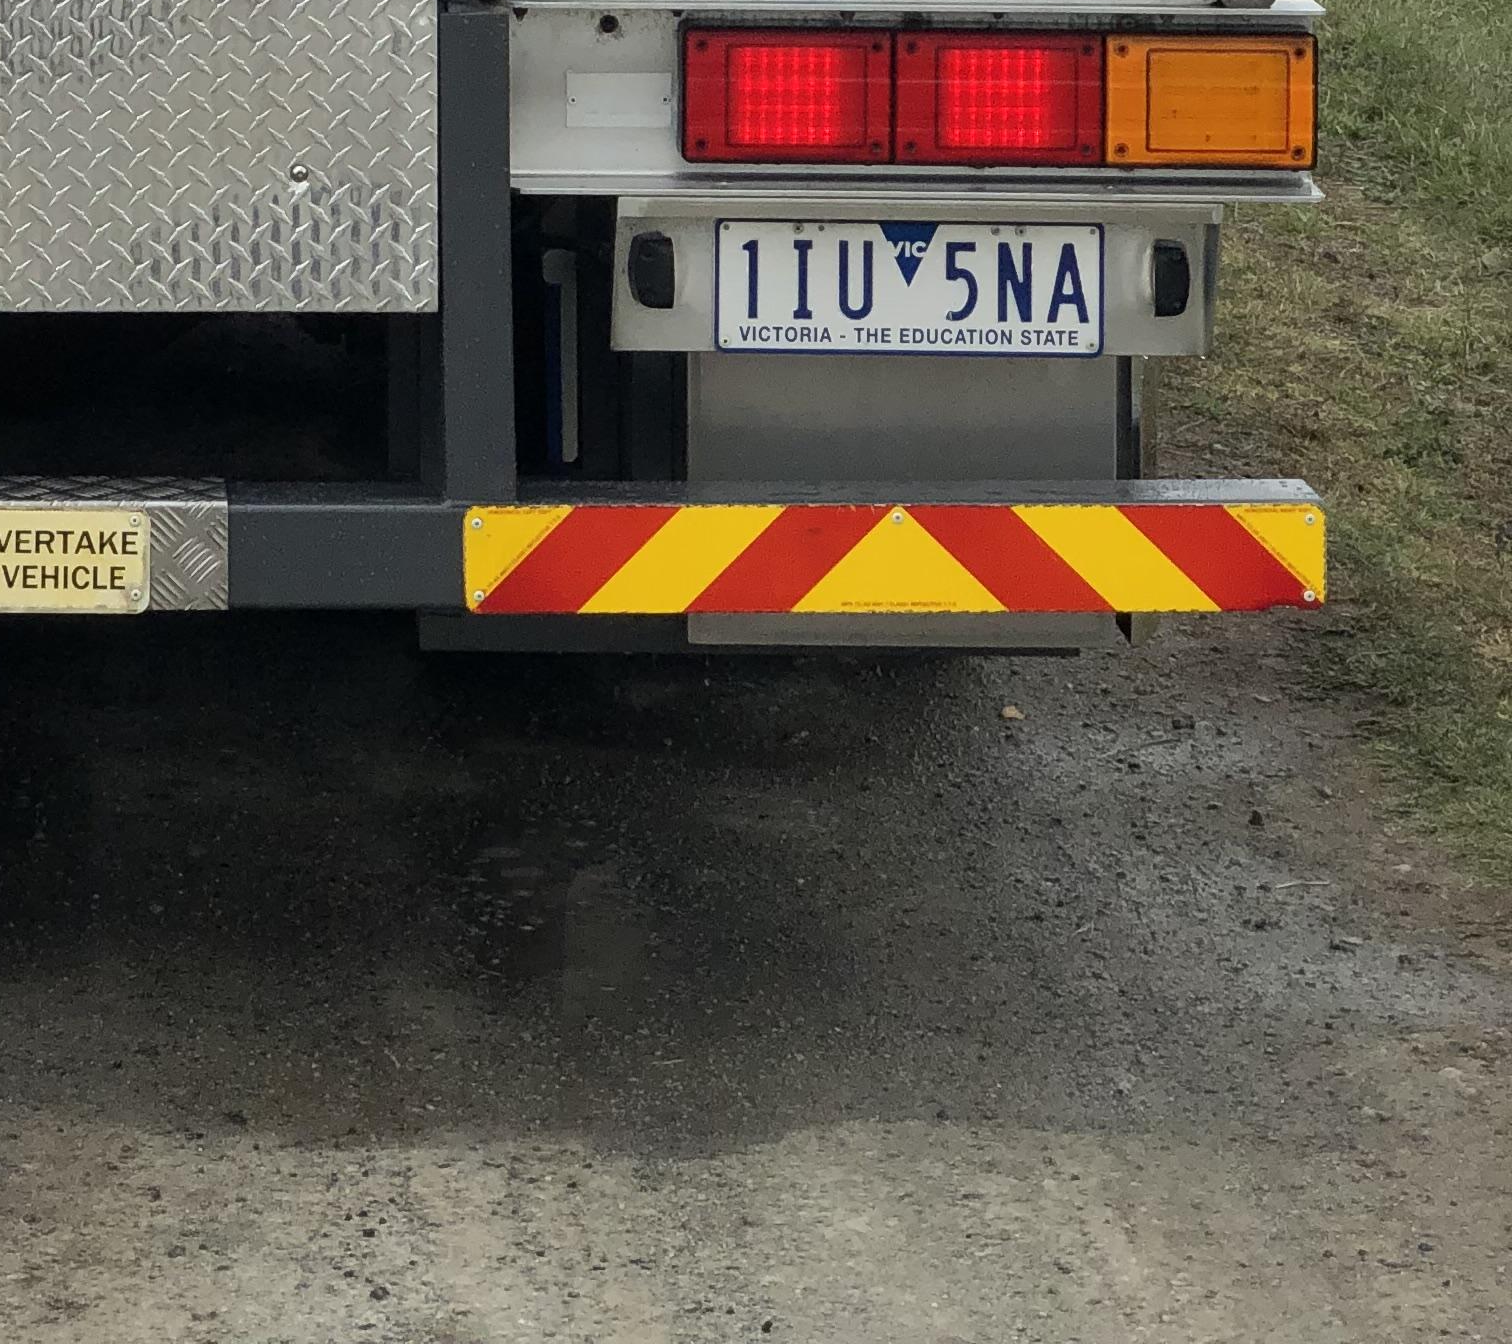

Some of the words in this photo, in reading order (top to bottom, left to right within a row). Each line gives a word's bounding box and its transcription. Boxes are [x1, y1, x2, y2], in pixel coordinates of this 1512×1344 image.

[888, 240, 927, 258] VIC
[739, 326, 832, 343] VICTORIA
[854, 327, 891, 343] THE
[899, 328, 1013, 345] EDUCATION
[1020, 329, 1080, 346] STATE
[1, 565, 127, 590] VEHICLE
